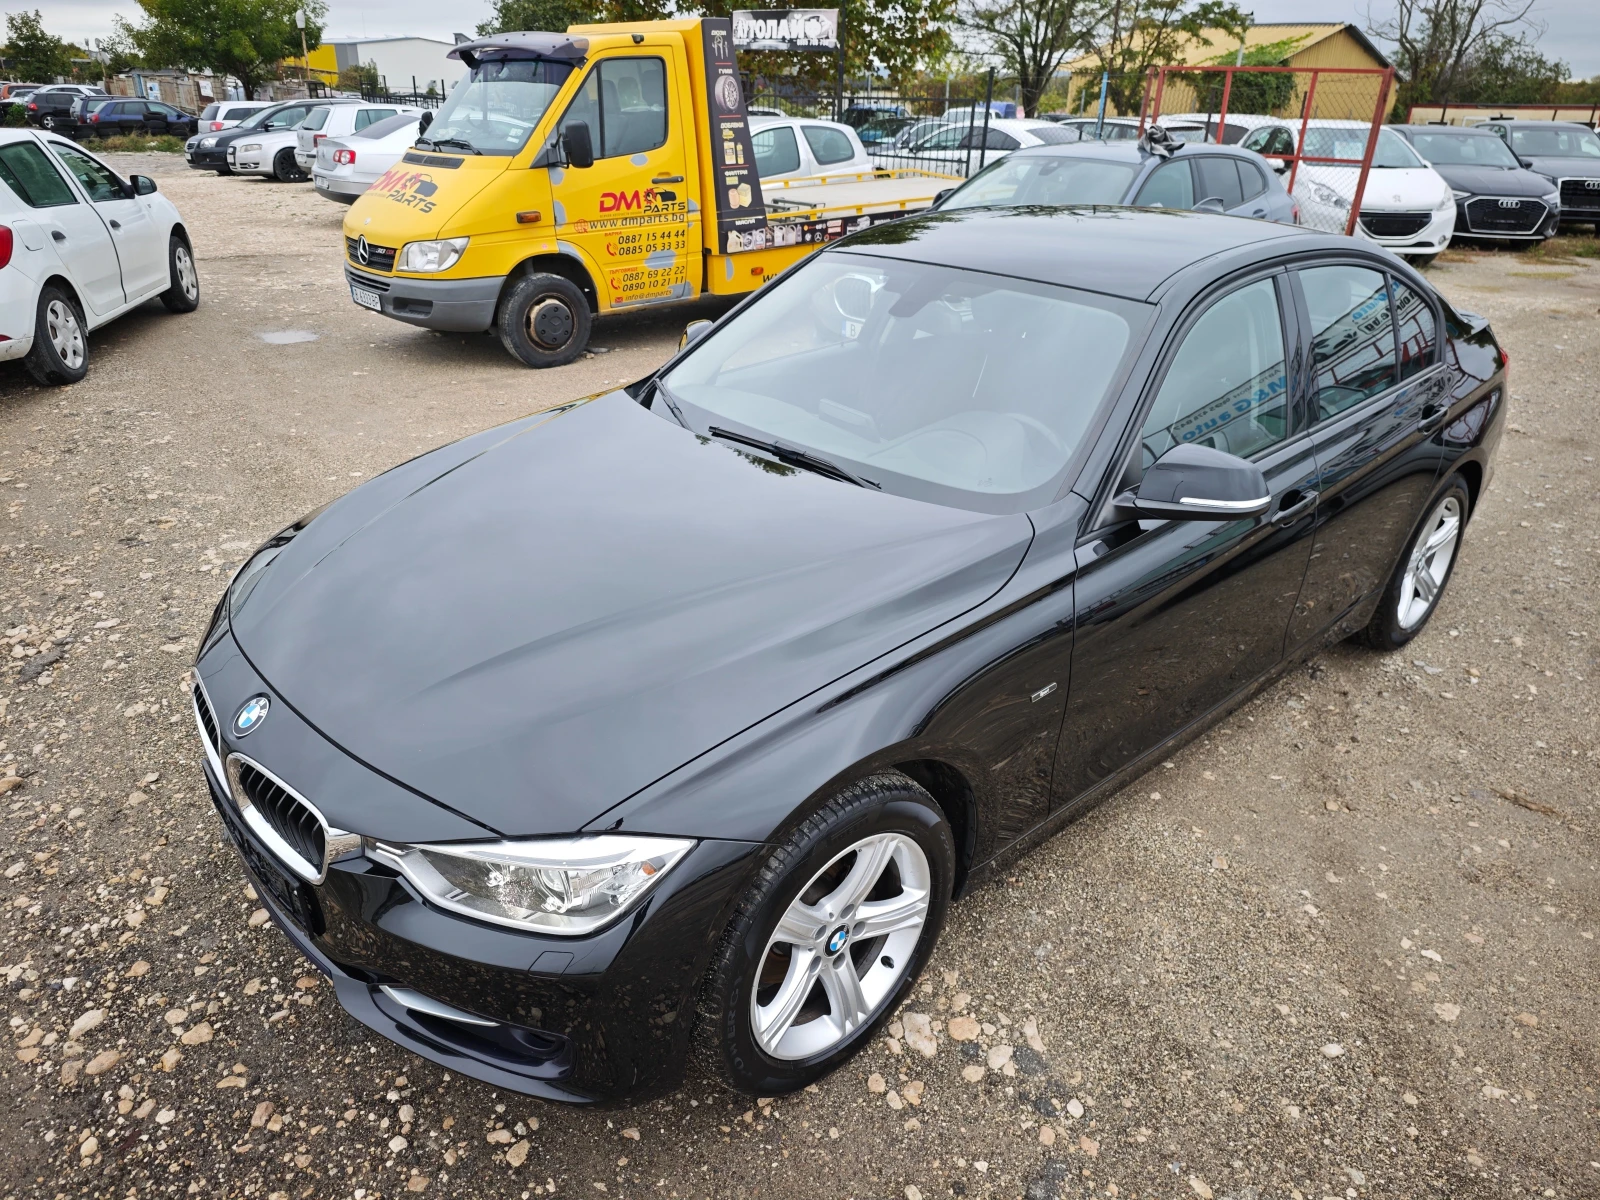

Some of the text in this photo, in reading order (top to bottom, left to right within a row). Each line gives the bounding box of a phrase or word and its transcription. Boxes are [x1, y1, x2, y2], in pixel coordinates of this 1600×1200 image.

[386, 189, 437, 214] PARTS
[599, 189, 642, 213] DM
[643, 201, 686, 214] PARTS
[589, 213, 685, 230] www.dmparts.bg
[618, 229, 685, 245] 0887 15 44 44
[618, 240, 686, 256] 0885 05 33 33
[622, 265, 685, 282] 0887 69 22 22
[622, 275, 684, 292] 0890 10 21 11
[625, 289, 672, 301] info@dmparts
[850, 323, 856, 338] B
